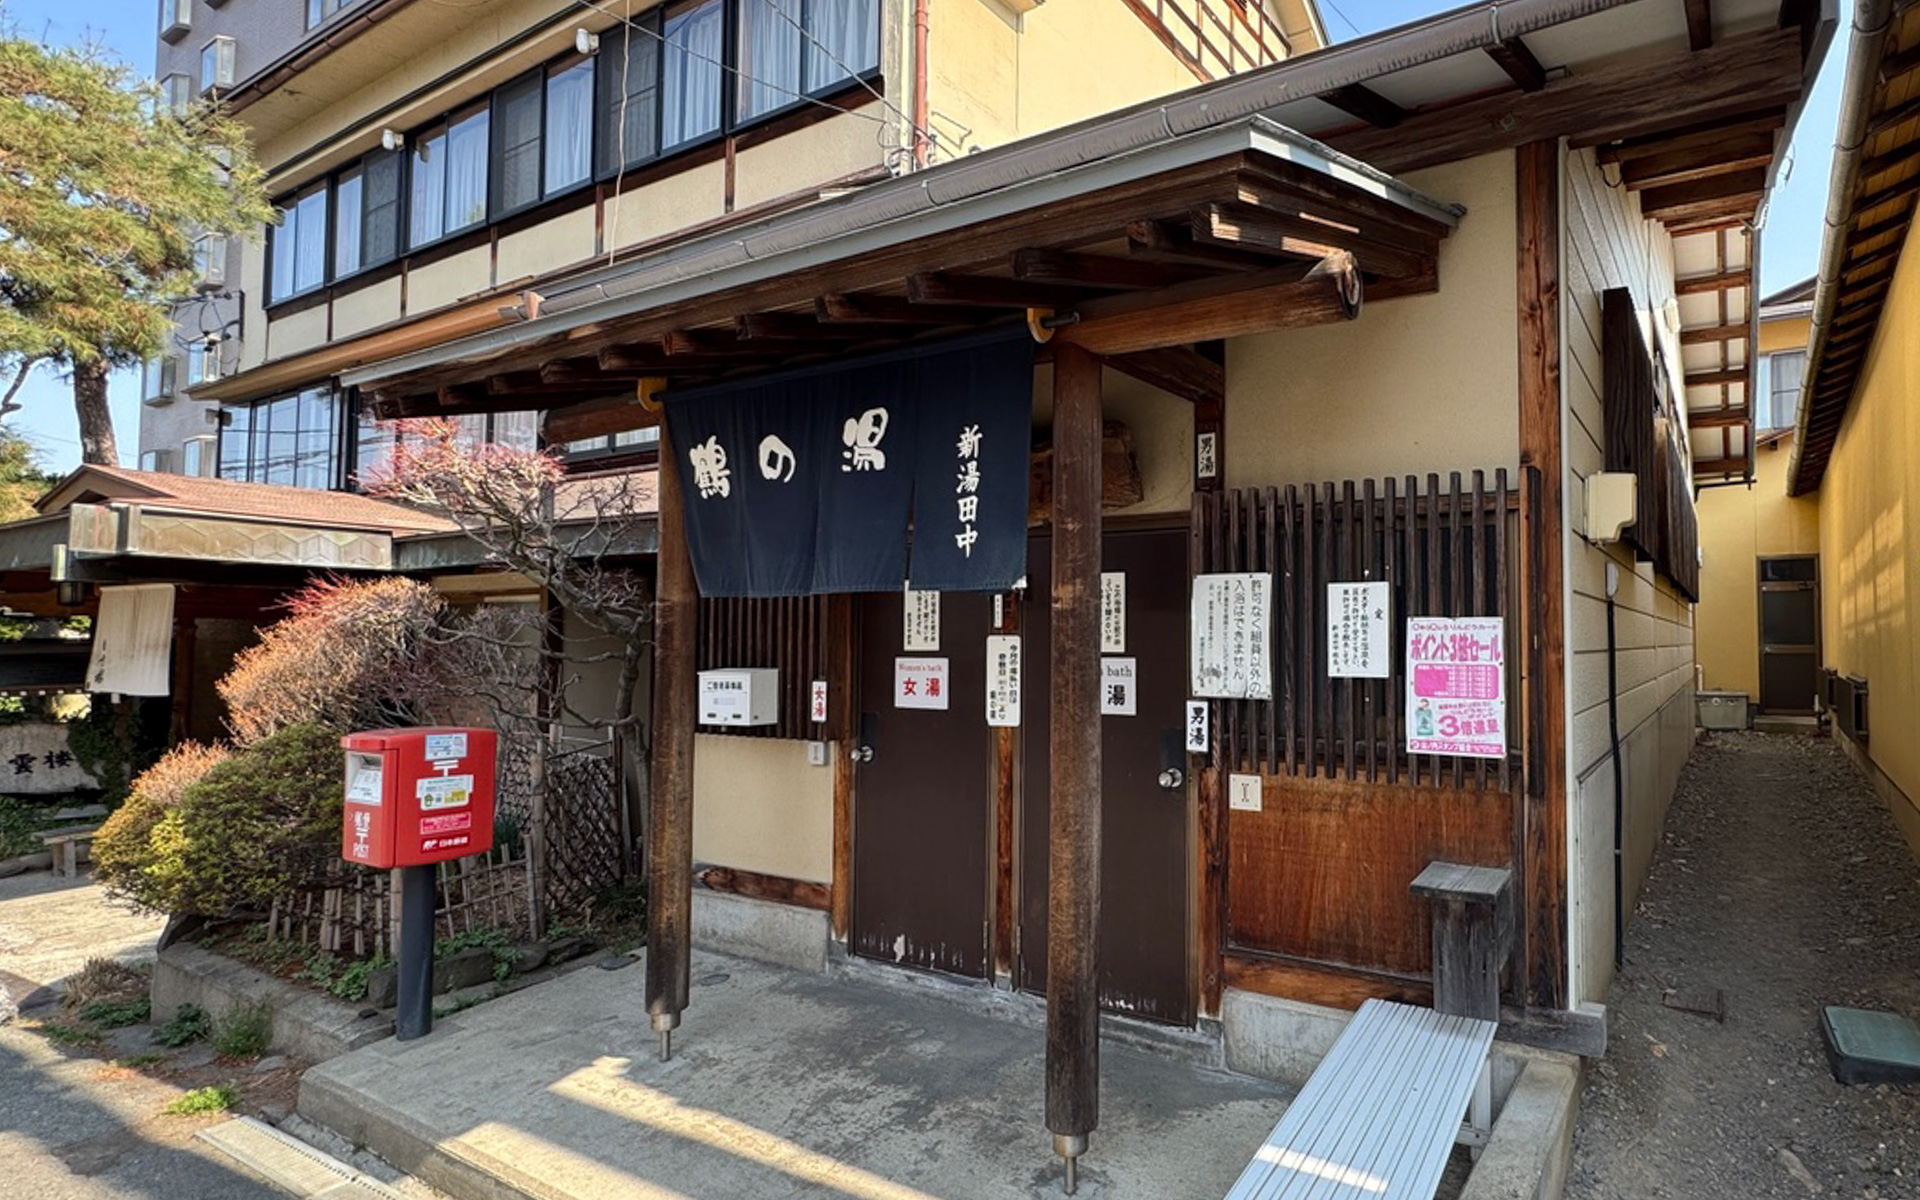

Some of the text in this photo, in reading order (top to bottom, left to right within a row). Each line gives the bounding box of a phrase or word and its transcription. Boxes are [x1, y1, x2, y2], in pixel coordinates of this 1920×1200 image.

[690, 407, 889, 499] 鶴の湯
[1200, 436, 1214, 473] 男湯
[955, 424, 983, 558] 新湯田中
[1233, 579, 1246, 681] 入浴はできません
[903, 677, 940, 697] 女湯
[1107, 664, 1133, 678] bath
[814, 686, 824, 717] 女湯
[1107, 684, 1125, 706] 湯
[1190, 707, 1204, 746] 男湯
